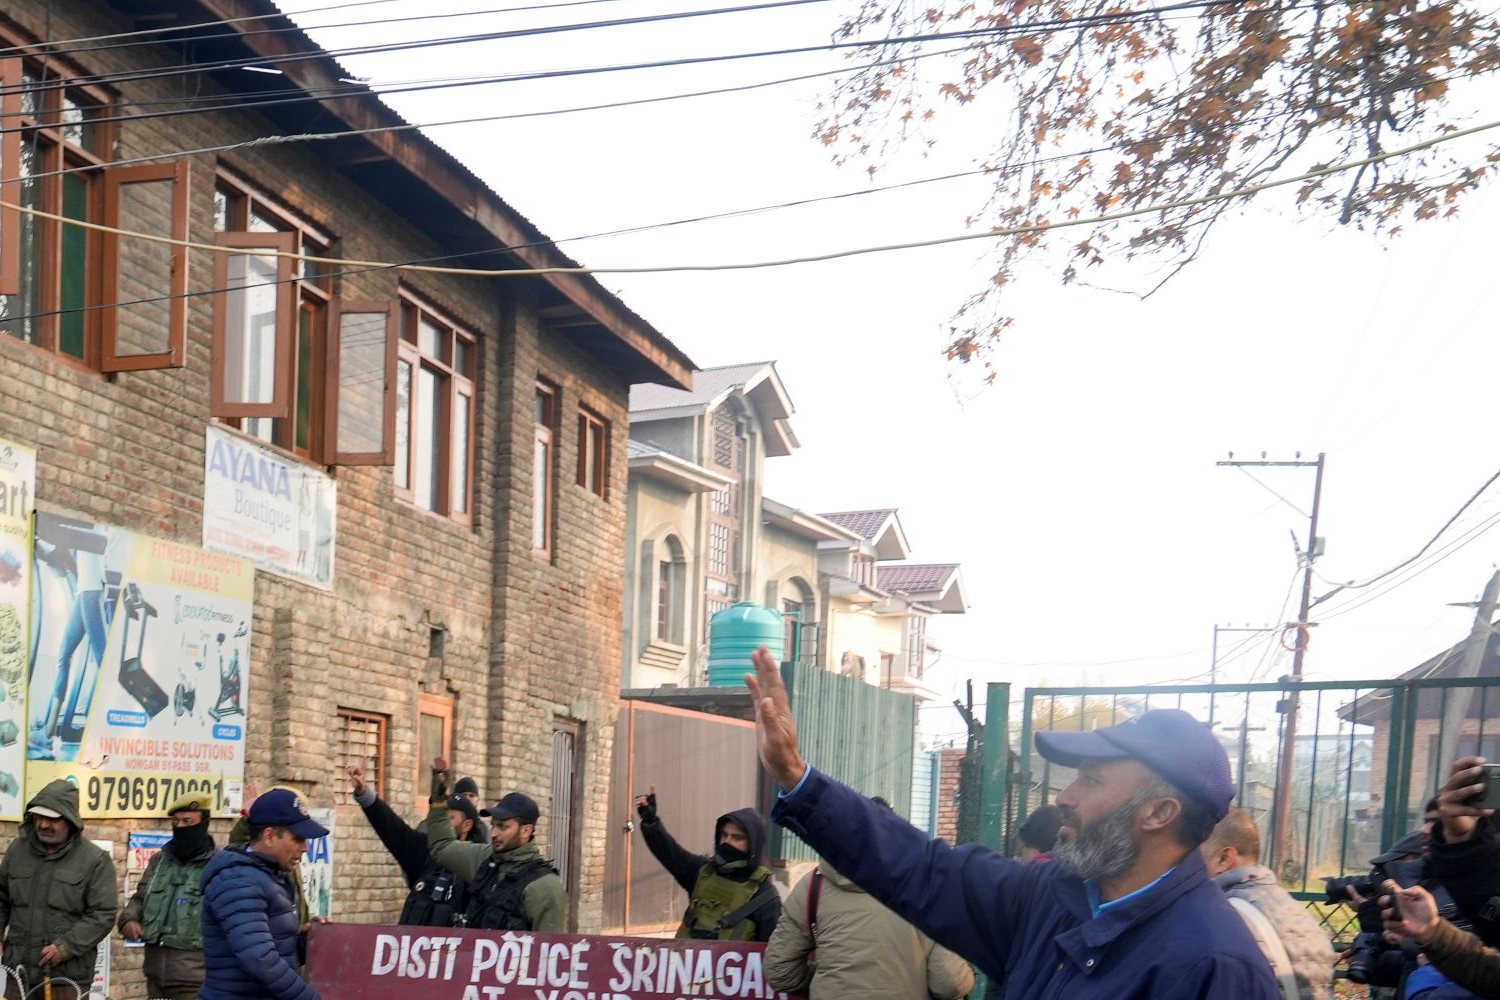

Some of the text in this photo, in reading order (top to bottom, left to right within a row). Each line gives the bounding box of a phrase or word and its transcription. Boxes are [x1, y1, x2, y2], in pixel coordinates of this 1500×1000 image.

[209, 439, 292, 501] AYANA
[234, 489, 292, 533] Boutique
[151, 541, 193, 566] FITNESS
[194, 549, 242, 577] PRODUCTS
[170, 567, 220, 593] AVAILABLE
[100, 737, 236, 761] INVINCIBLE SOLUTIONS
[371, 931, 788, 1000] DISTT POLICE SRINAGA
